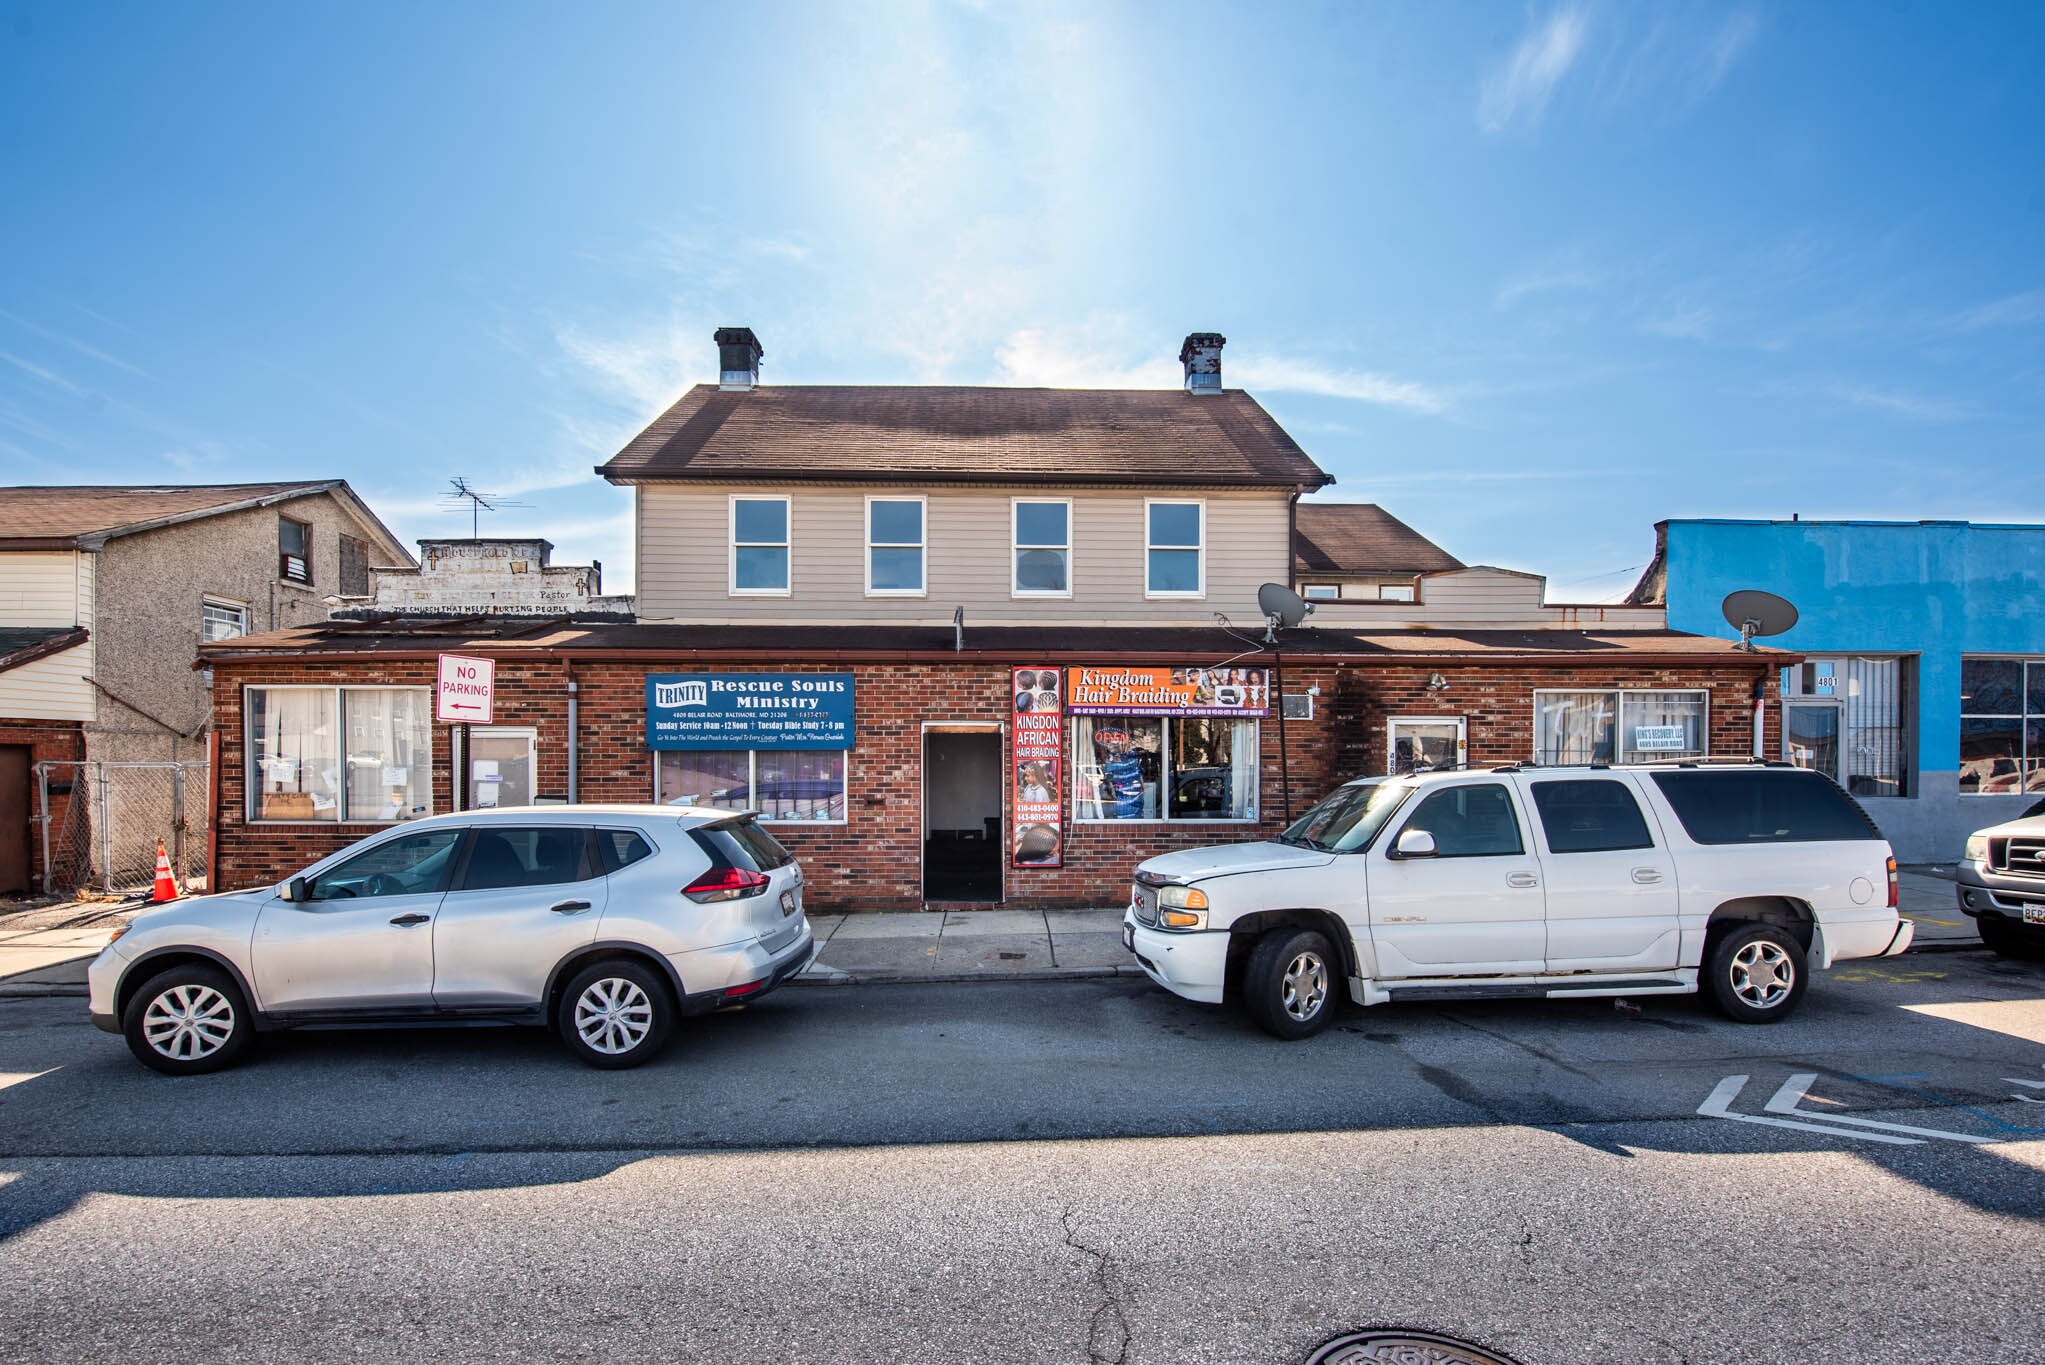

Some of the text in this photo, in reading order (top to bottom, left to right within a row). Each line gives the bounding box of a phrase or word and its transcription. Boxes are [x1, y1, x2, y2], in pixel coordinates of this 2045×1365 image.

[539, 591, 570, 600] Pastor
[441, 605, 462, 613] THAT
[465, 605, 489, 613] HELPS
[492, 605, 533, 614] HURTING
[535, 605, 568, 613] PEOPLE
[456, 666, 477, 680] NO
[1080, 669, 1153, 687] Kingdom
[711, 679, 845, 692] Rescue Souls
[1818, 678, 1838, 686] 4801
[442, 681, 489, 697] PARKING
[657, 685, 705, 704] TRINITY
[736, 696, 819, 709] Ministry
[1074, 686, 1190, 707] Hair Braiding
[655, 721, 678, 730] Sunday
[679, 721, 702, 730] Service
[703, 721, 720, 730] 10am
[758, 721, 783, 730] Tuesday
[784, 721, 801, 730] Bible
[802, 721, 819, 730] Study
[834, 722, 845, 730] pm
[1016, 715, 1059, 730] KINGDON
[1016, 731, 1059, 746] AFRICAN
[1094, 732, 1129, 743] OPEN
[1016, 747, 1060, 758] HAIR BRAIDING
